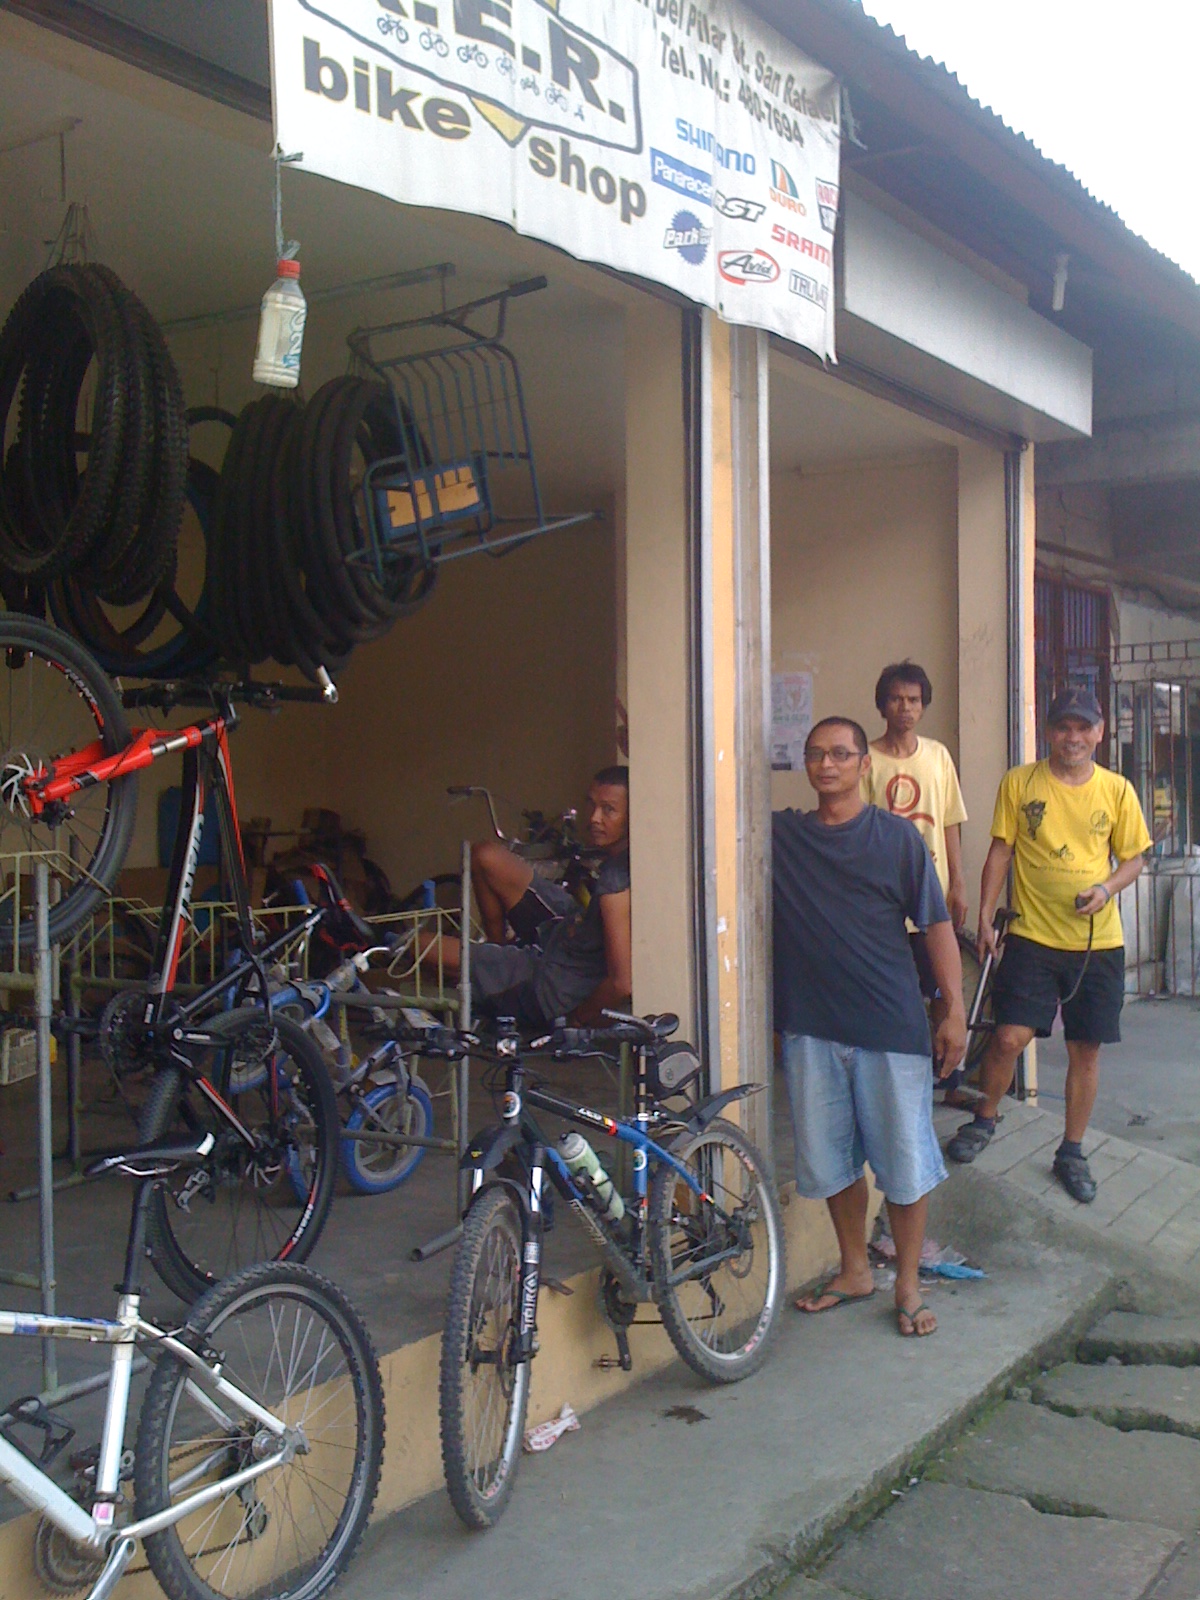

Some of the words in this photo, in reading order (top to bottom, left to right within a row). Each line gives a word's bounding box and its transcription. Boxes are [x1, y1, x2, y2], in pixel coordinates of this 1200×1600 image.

[660, 31, 695, 80] Tel.
[685, 3, 726, 54] Pilar
[754, 50, 782, 97] San
[302, 36, 472, 140] bike
[528, 136, 648, 225] shop
[653, 154, 712, 200] Panarace
[768, 186, 808, 217] DURO
[722, 254, 774, 279] Avid
[771, 223, 831, 268] SRAM
